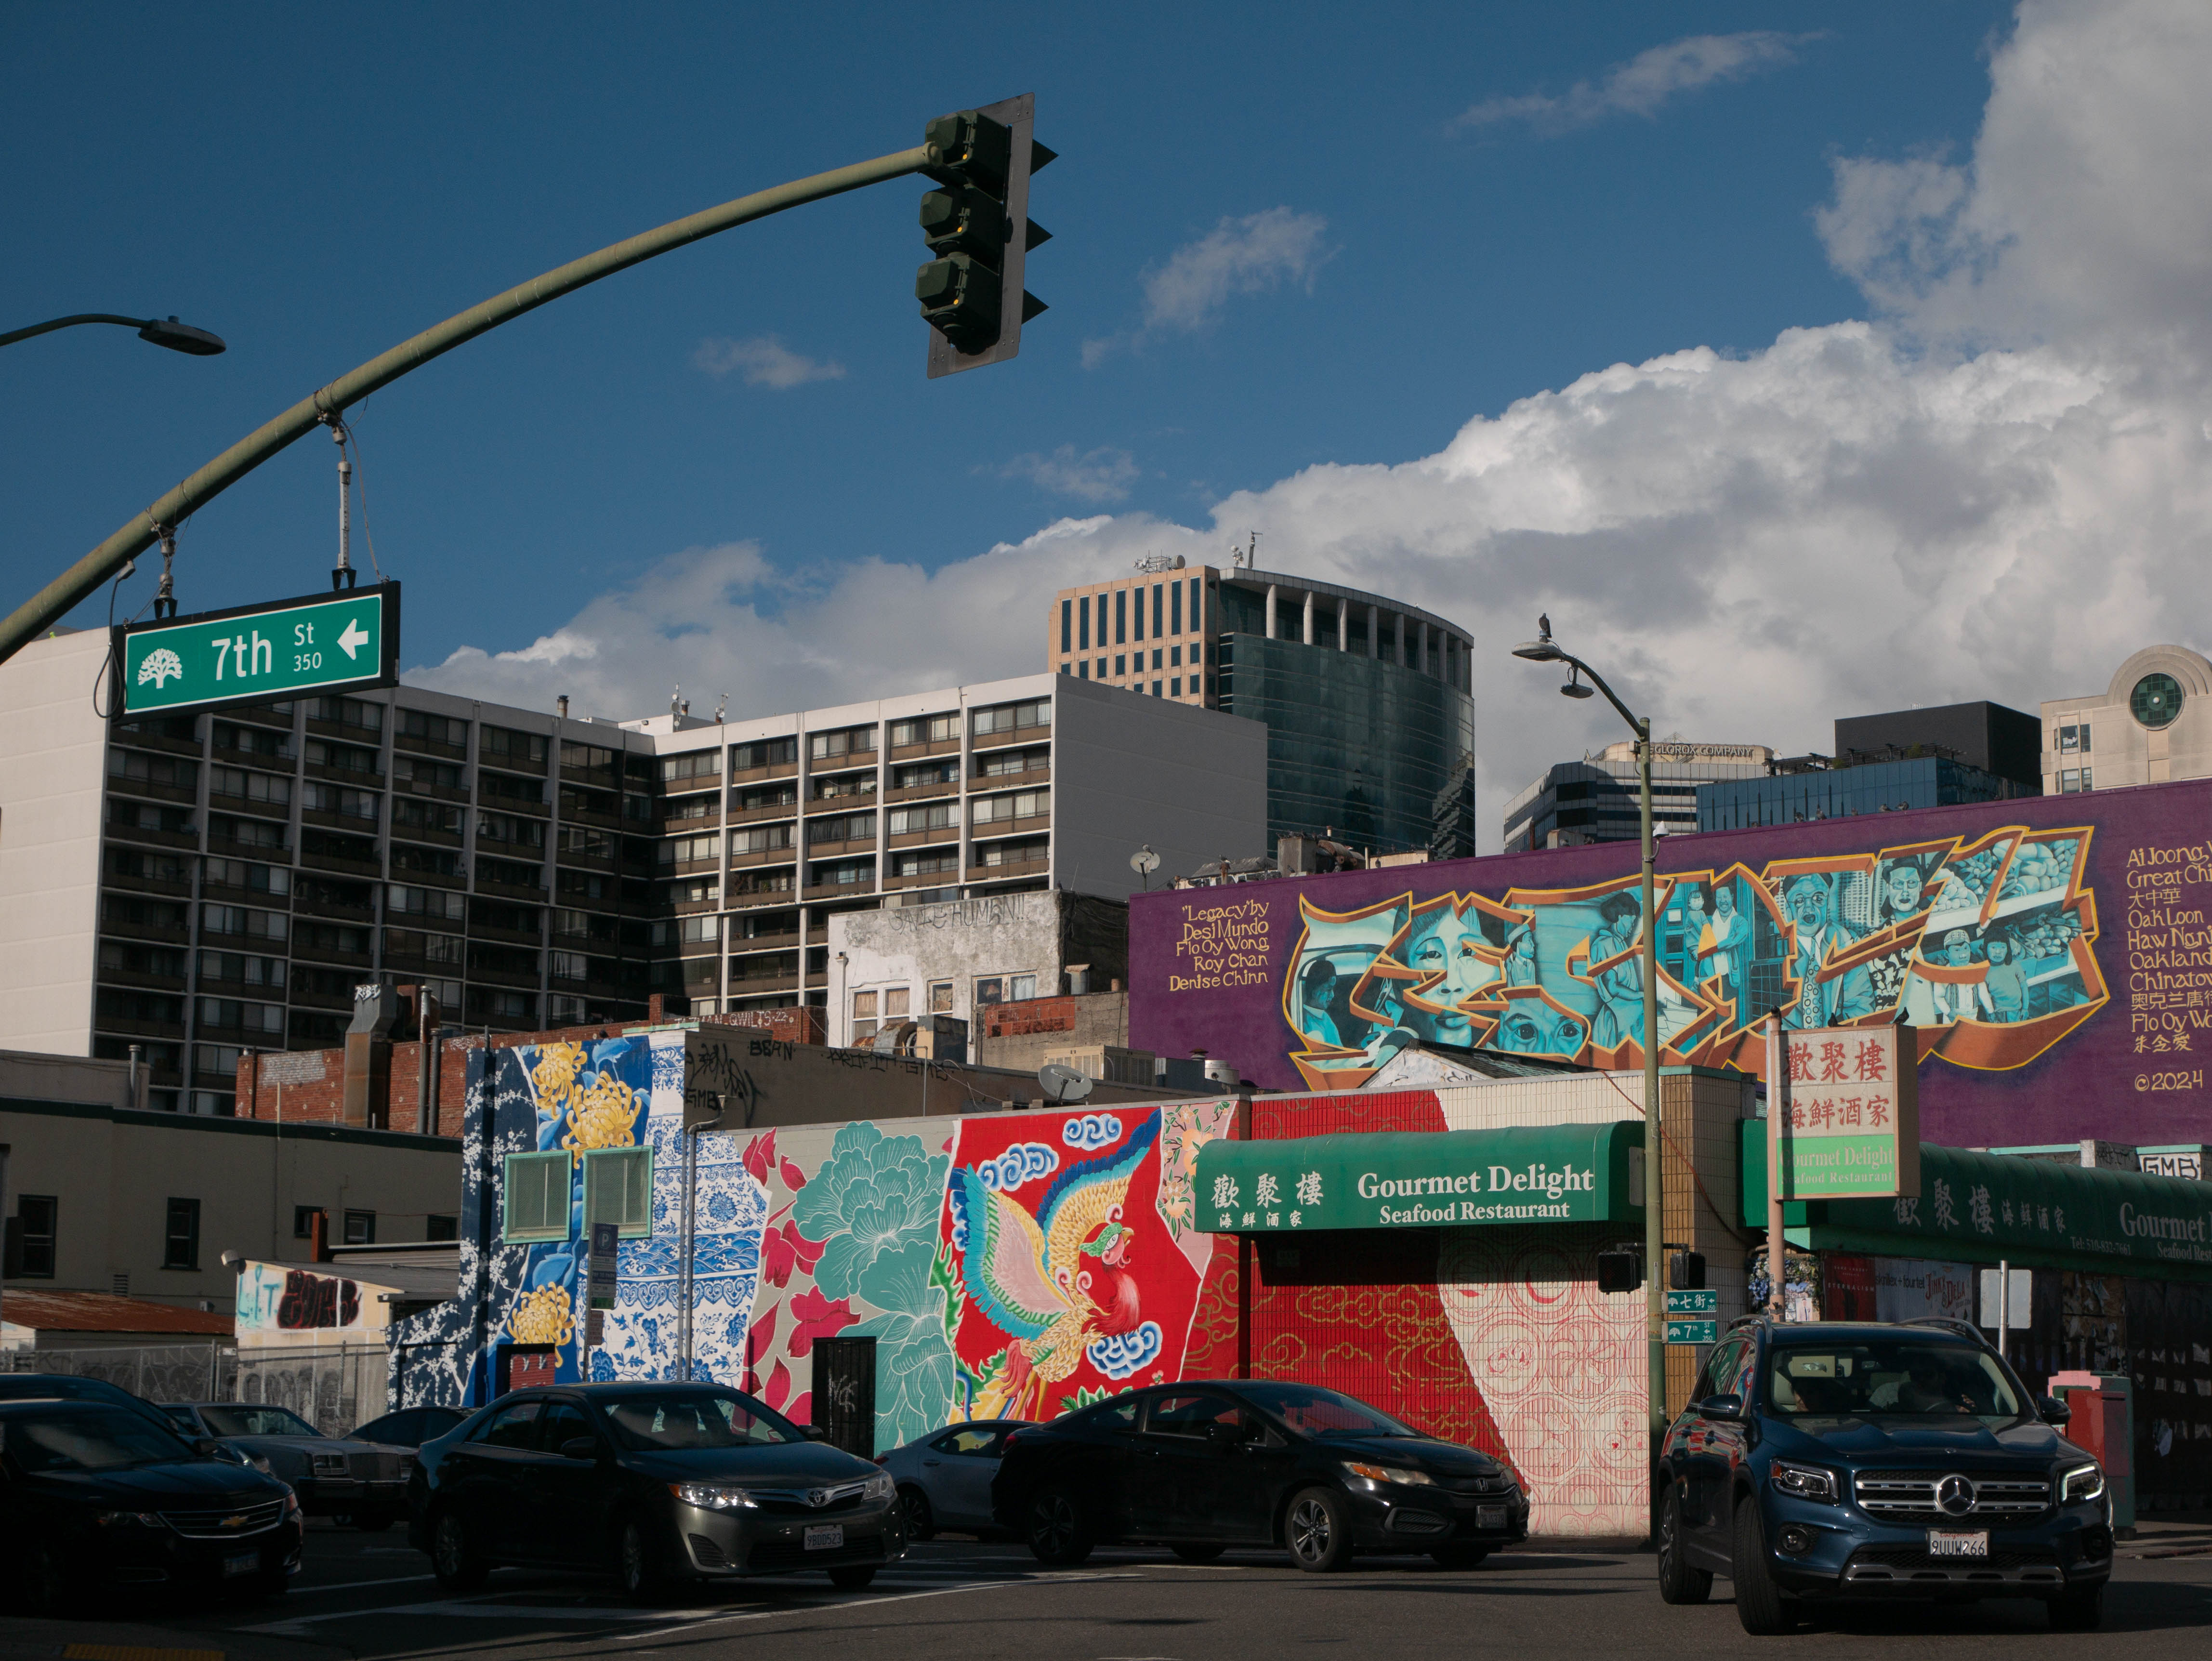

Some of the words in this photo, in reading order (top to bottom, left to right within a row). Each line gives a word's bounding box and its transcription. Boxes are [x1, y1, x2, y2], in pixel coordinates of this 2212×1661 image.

[212, 630, 272, 681] 7th
[294, 622, 314, 646] St
[293, 652, 322, 672] 350
[1654, 745, 1696, 755] CLOROX
[1699, 746, 1752, 756] COMPANY
[2127, 847, 2145, 867] Ai
[2147, 846, 2210, 865] Joong
[2127, 870, 2183, 888] Great
[1250, 899, 1269, 917] by
[2128, 887, 2181, 910] 大中華
[1183, 923, 1215, 941] Desi
[1217, 917, 1269, 938] Mundo
[2128, 909, 2165, 929] Oak
[2166, 908, 2204, 926] Loon
[1176, 941, 1199, 956] Flo
[1202, 940, 1224, 956] Oy
[1224, 936, 1269, 951] Wong
[2127, 929, 2168, 950] Haw
[1194, 956, 1225, 973] Roy
[1228, 953, 1268, 968] Chan
[2130, 946, 2212, 970] Oakland
[1169, 974, 1221, 991] Denise
[1223, 969, 1268, 986] Chinn
[2131, 1014, 2159, 1032] Flo
[2161, 1012, 2188, 1033] Oy
[1783, 1038, 1887, 1084] 歡聚樓
[1783, 1094, 1890, 1130] 海鮮酒家
[1779, 1148, 1841, 1168] Gourmet
[1844, 1146, 1894, 1169] Delight
[1357, 1171, 1482, 1199] Gourmet
[1487, 1163, 1594, 1200] Delight
[1830, 1171, 1893, 1183] Restaurant
[1211, 1171, 1324, 1210] 歡聚樓
[1219, 1211, 1303, 1229] 海鮮酒家
[1379, 1204, 1458, 1226] Seafood
[1460, 1201, 1570, 1222] Restaurant
[2120, 1202, 2206, 1243] Gourmet
[2158, 1241, 2192, 1260] Seafood
[1680, 1294, 1705, 1308] 七街
[1684, 1324, 1698, 1339] 7th
[1932, 1541, 1985, 1556] 9UUW266
